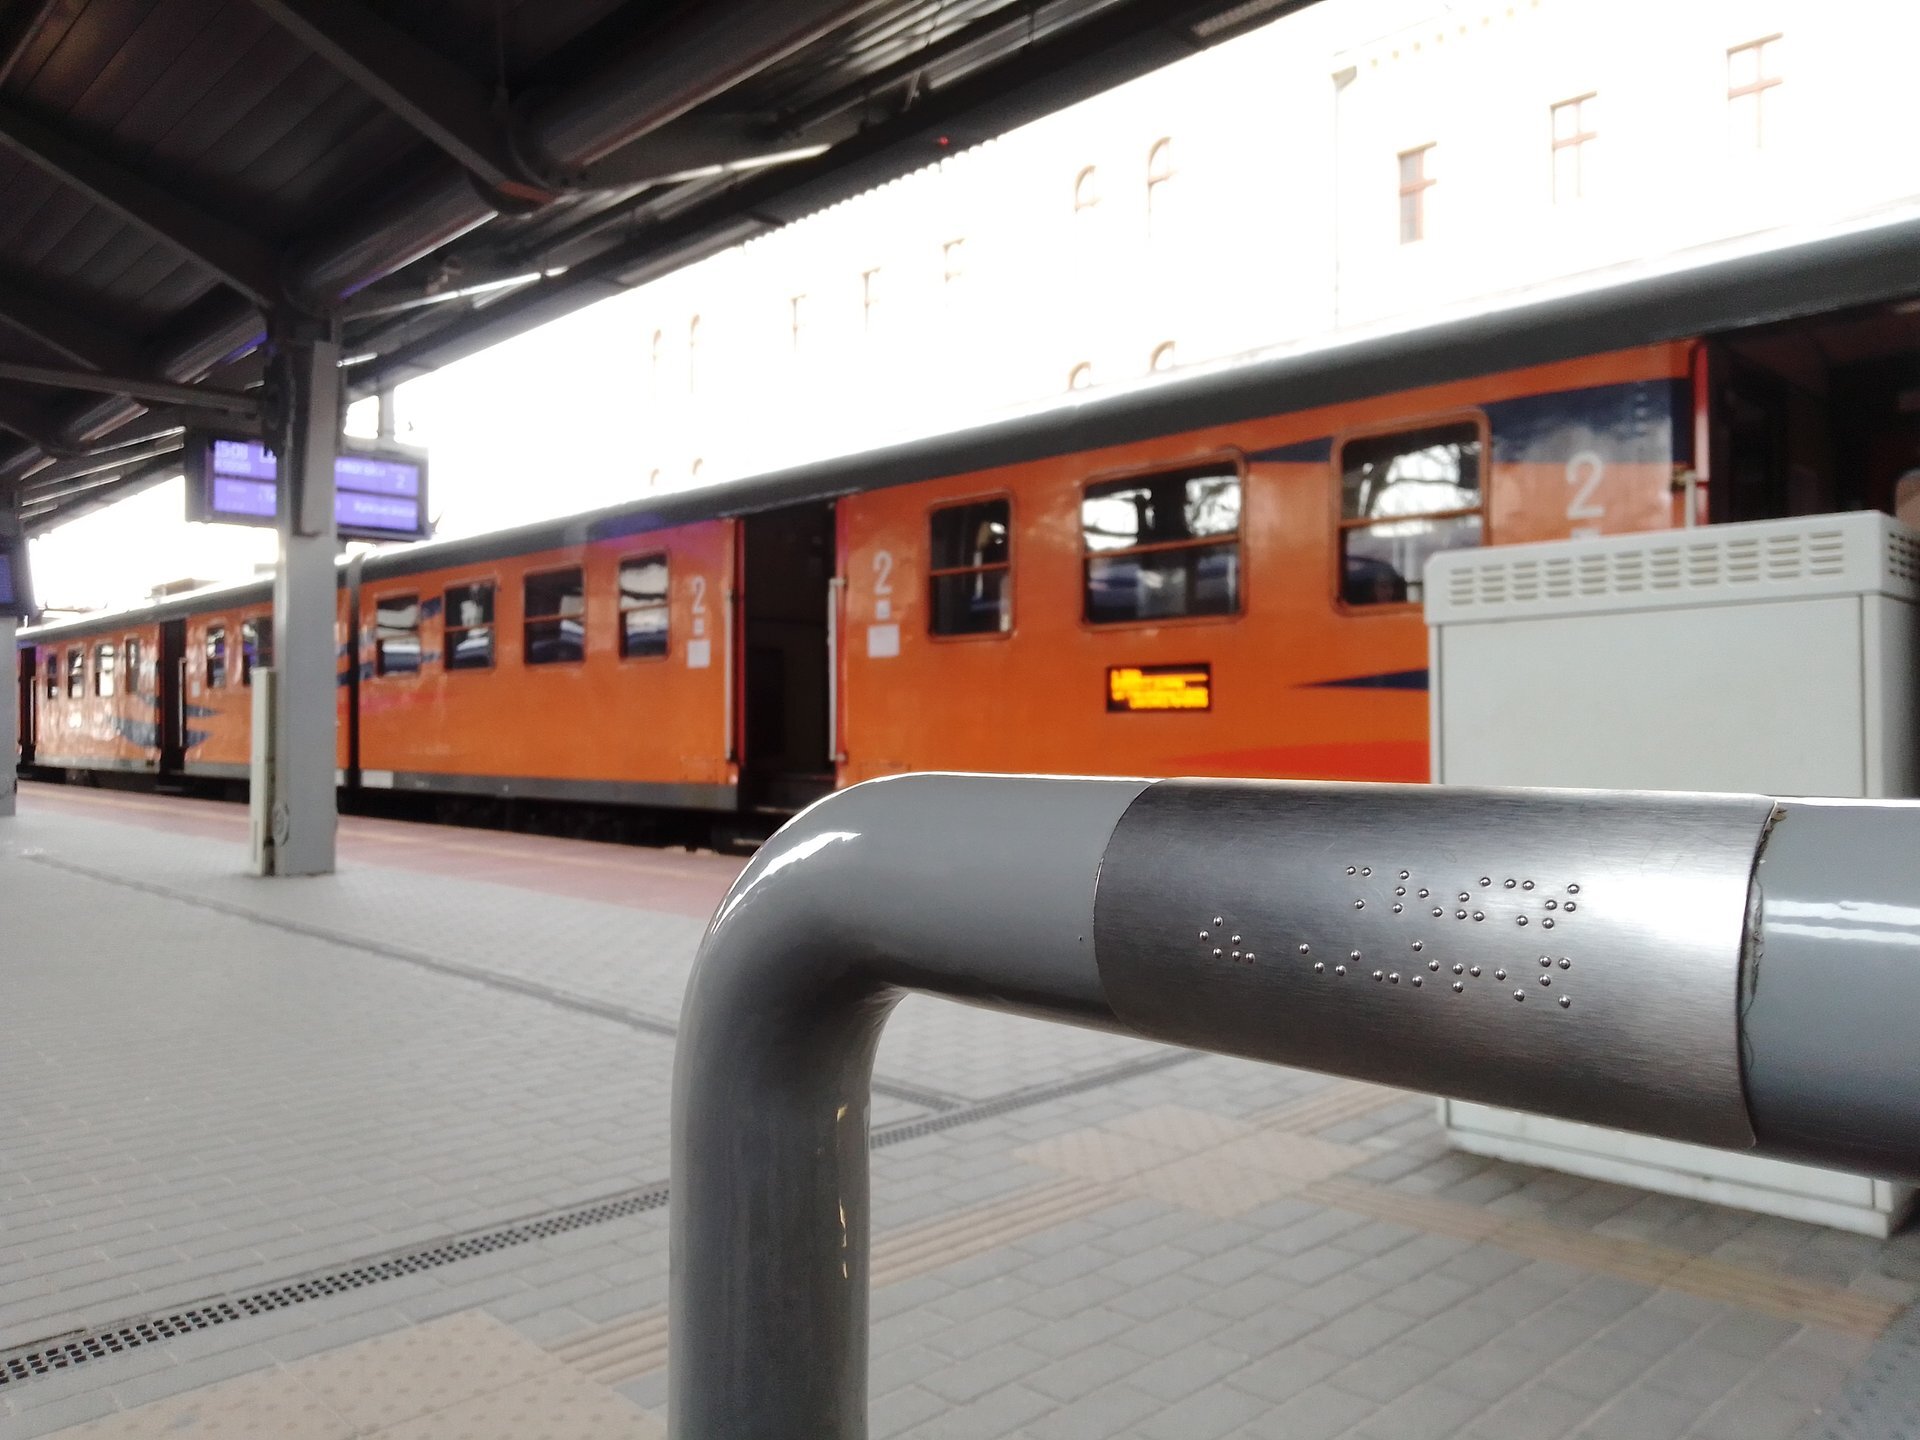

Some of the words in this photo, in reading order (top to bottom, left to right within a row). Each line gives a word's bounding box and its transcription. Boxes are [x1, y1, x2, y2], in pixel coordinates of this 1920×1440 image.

[1567, 451, 1605, 519] 2
[874, 551, 893, 595] 2
[691, 576, 706, 615] 2
